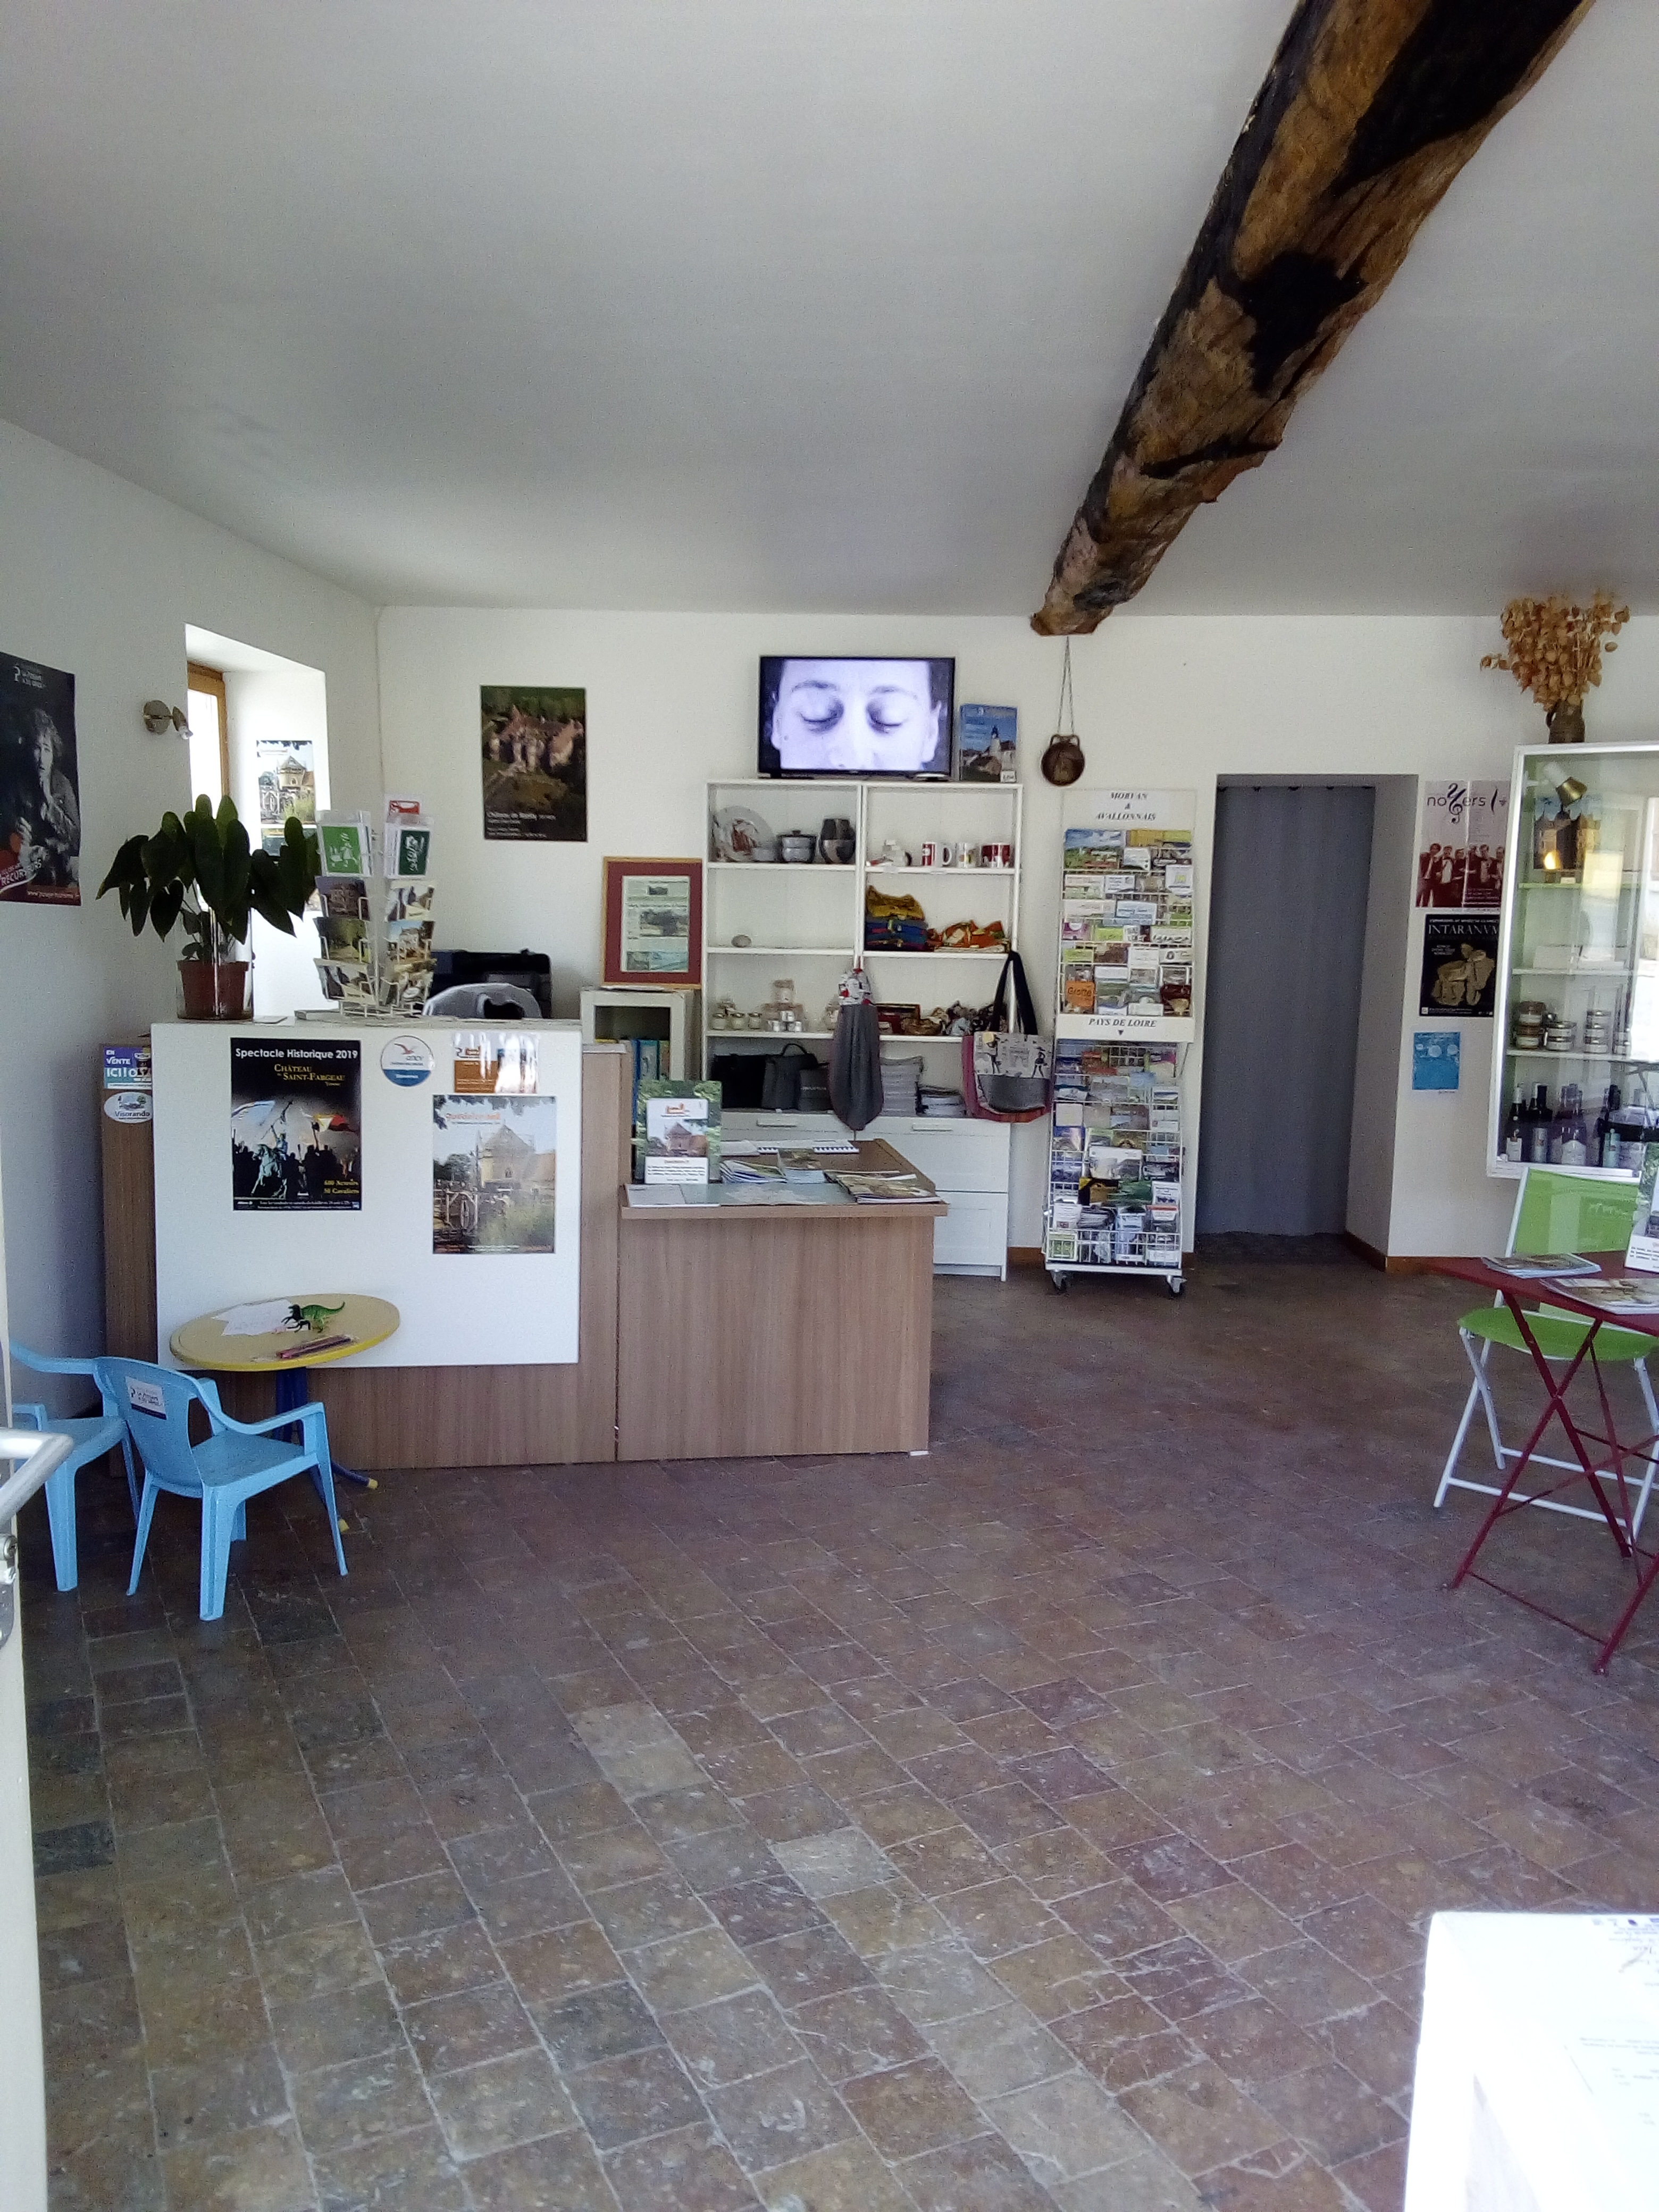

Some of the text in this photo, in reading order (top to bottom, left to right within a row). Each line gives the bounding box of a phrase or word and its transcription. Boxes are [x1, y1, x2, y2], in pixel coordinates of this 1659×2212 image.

[1088, 1018, 1111, 1026] PAYS
[1127, 1019, 1157, 1028] LOIRE
[235, 1048, 358, 1060] Spectacle Historique 2019
